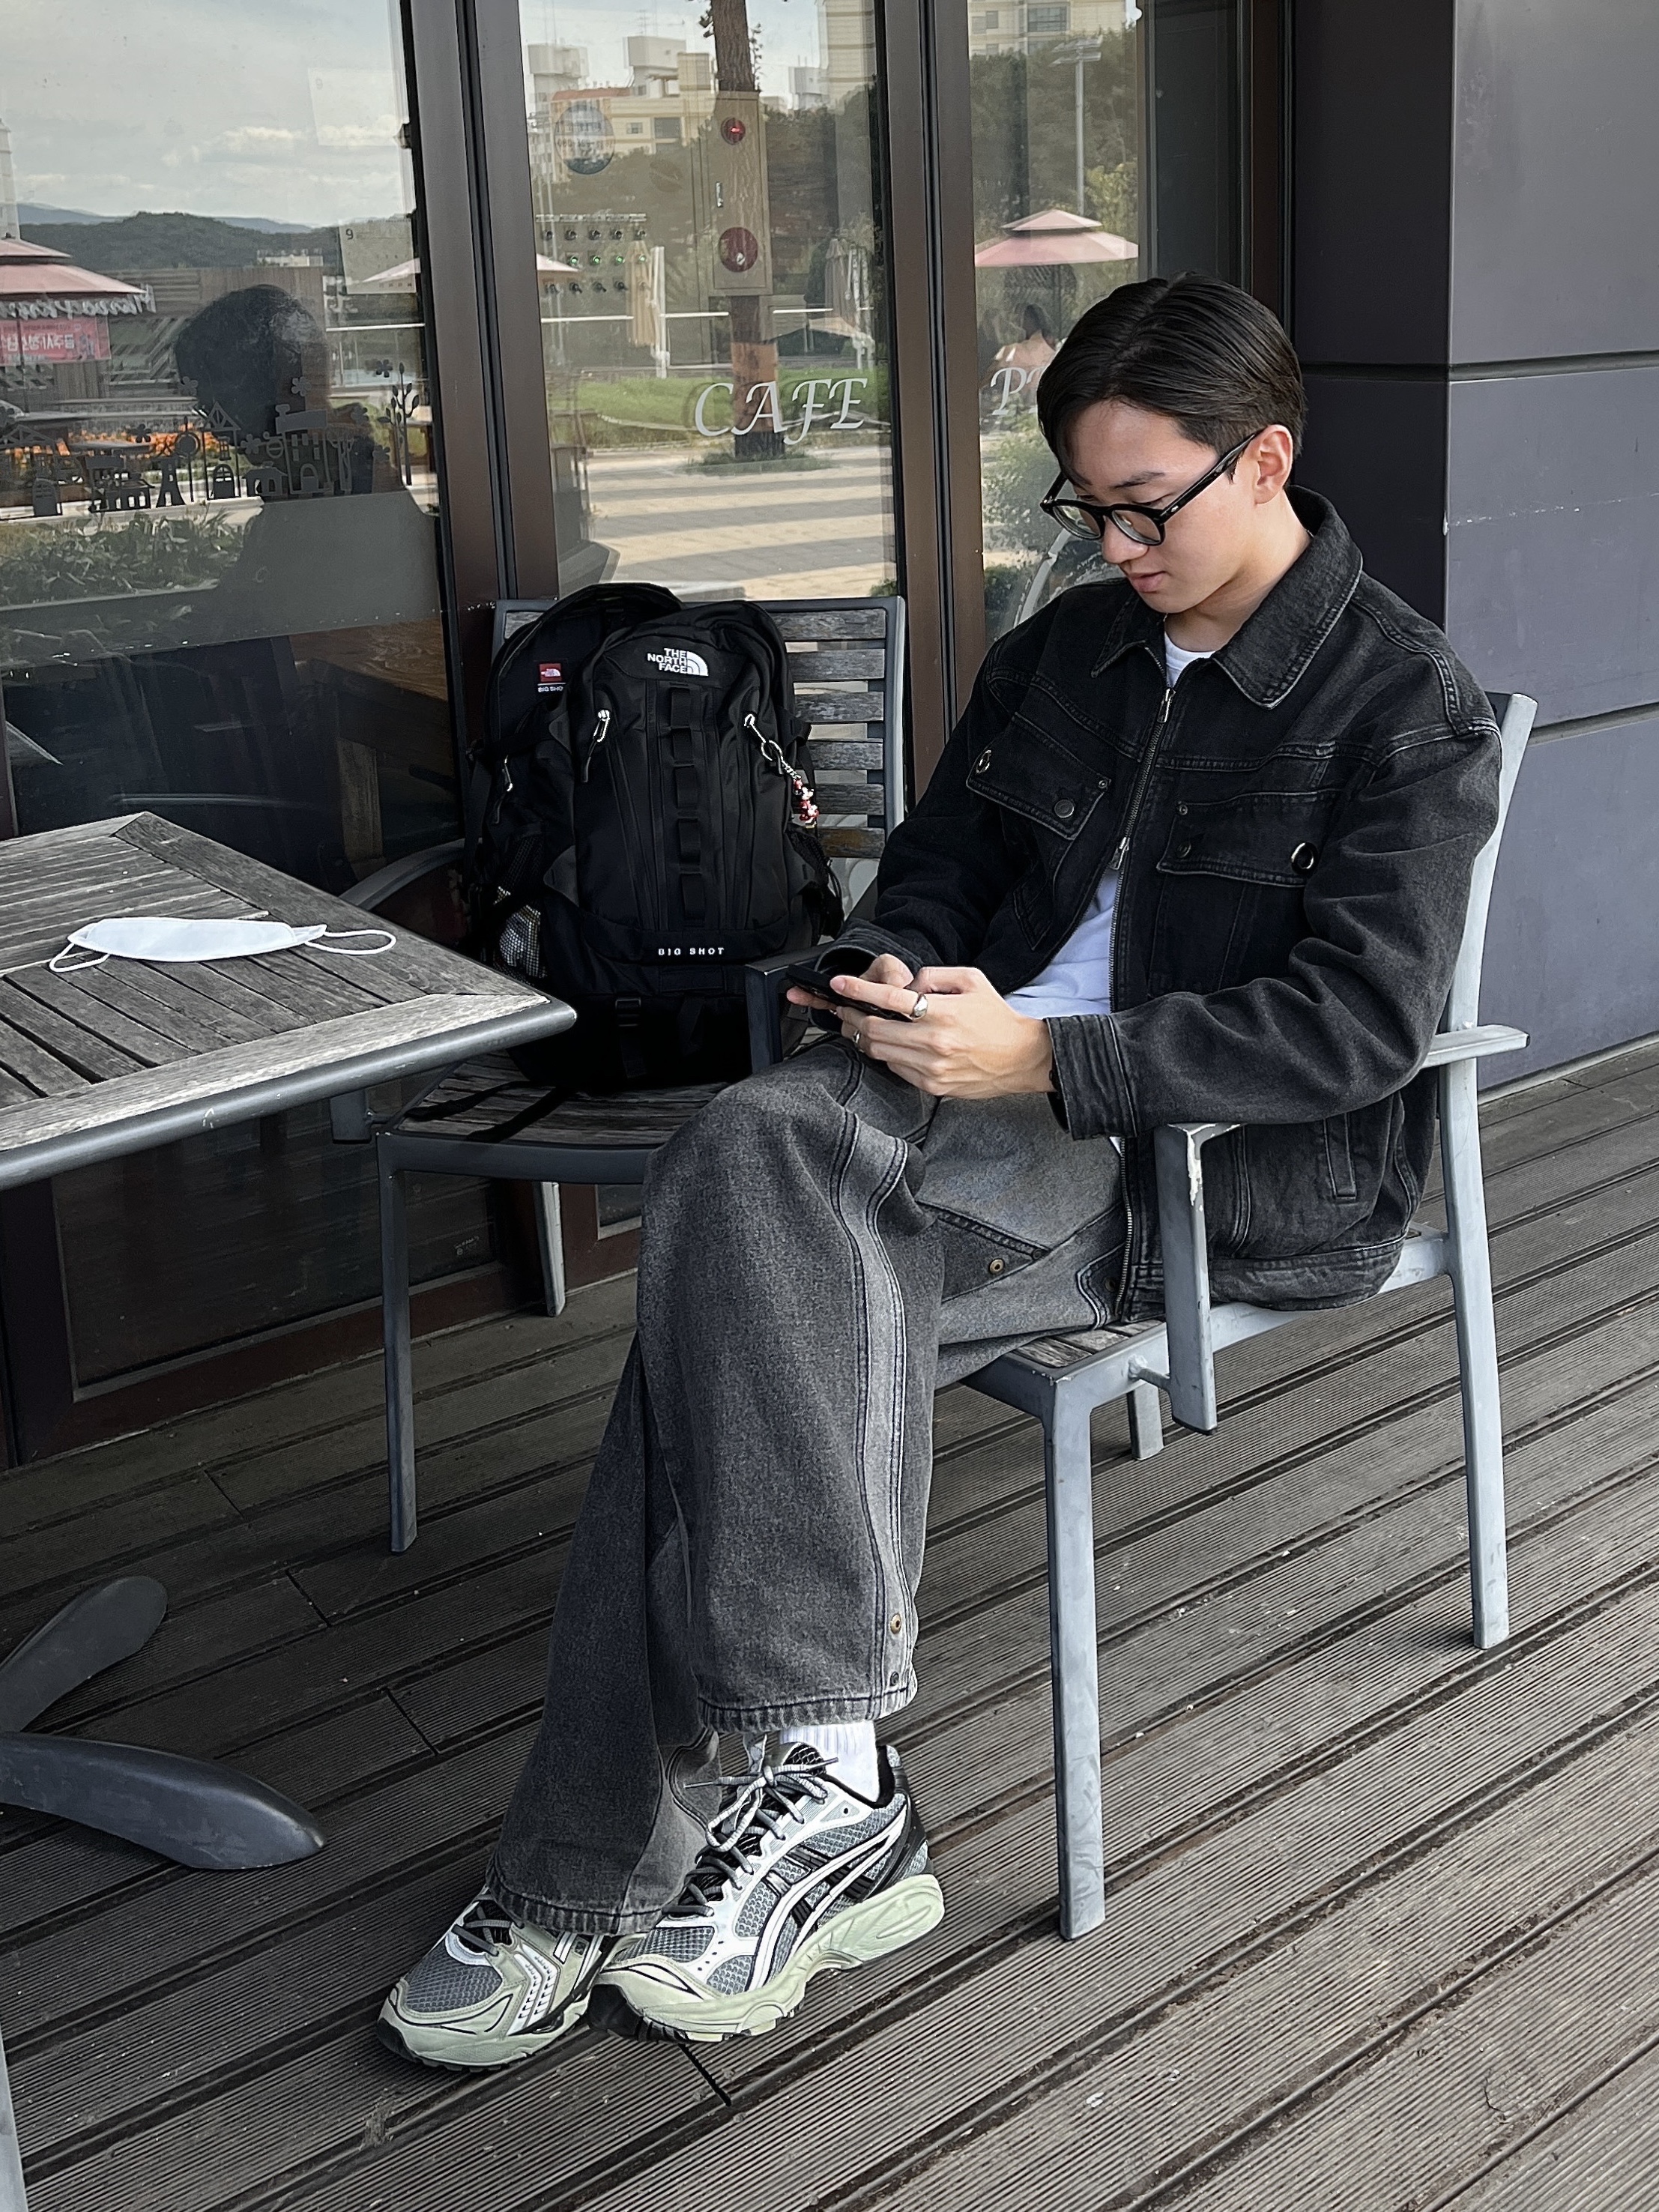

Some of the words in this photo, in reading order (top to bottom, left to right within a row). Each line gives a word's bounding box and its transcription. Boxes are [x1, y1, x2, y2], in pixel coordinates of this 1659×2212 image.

[345, 229, 354, 240] 9
[695, 378, 875, 445] CAFE
[664, 647, 687, 659] THE
[647, 653, 687, 667] NORTH
[659, 662, 687, 674] FACE
[658, 948, 681, 956] BIG
[689, 947, 725, 955] SHOT
